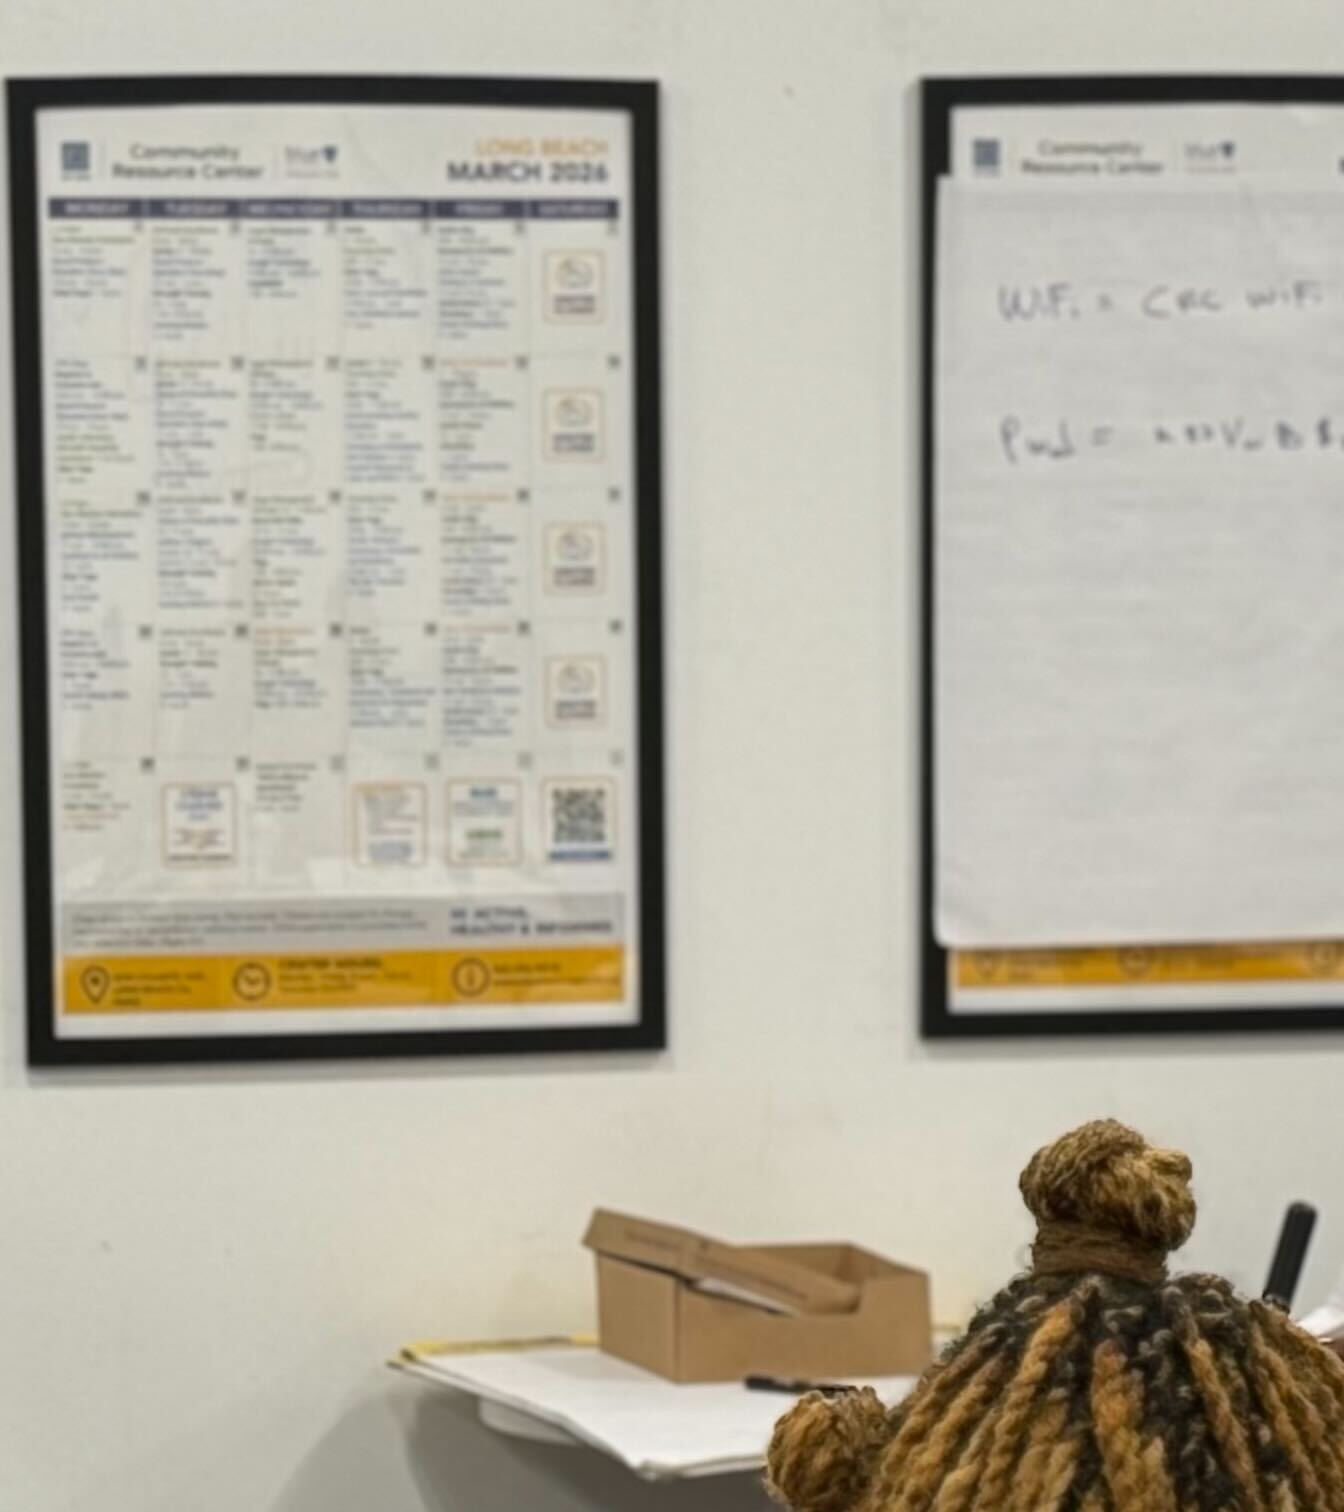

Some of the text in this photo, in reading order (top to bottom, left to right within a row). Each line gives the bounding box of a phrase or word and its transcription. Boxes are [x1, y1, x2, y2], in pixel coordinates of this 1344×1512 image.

[129, 142, 240, 163] Community
[477, 138, 609, 157] LONG BEACH
[111, 162, 264, 179] Resource Center
[447, 160, 609, 182] MARCH 2026
